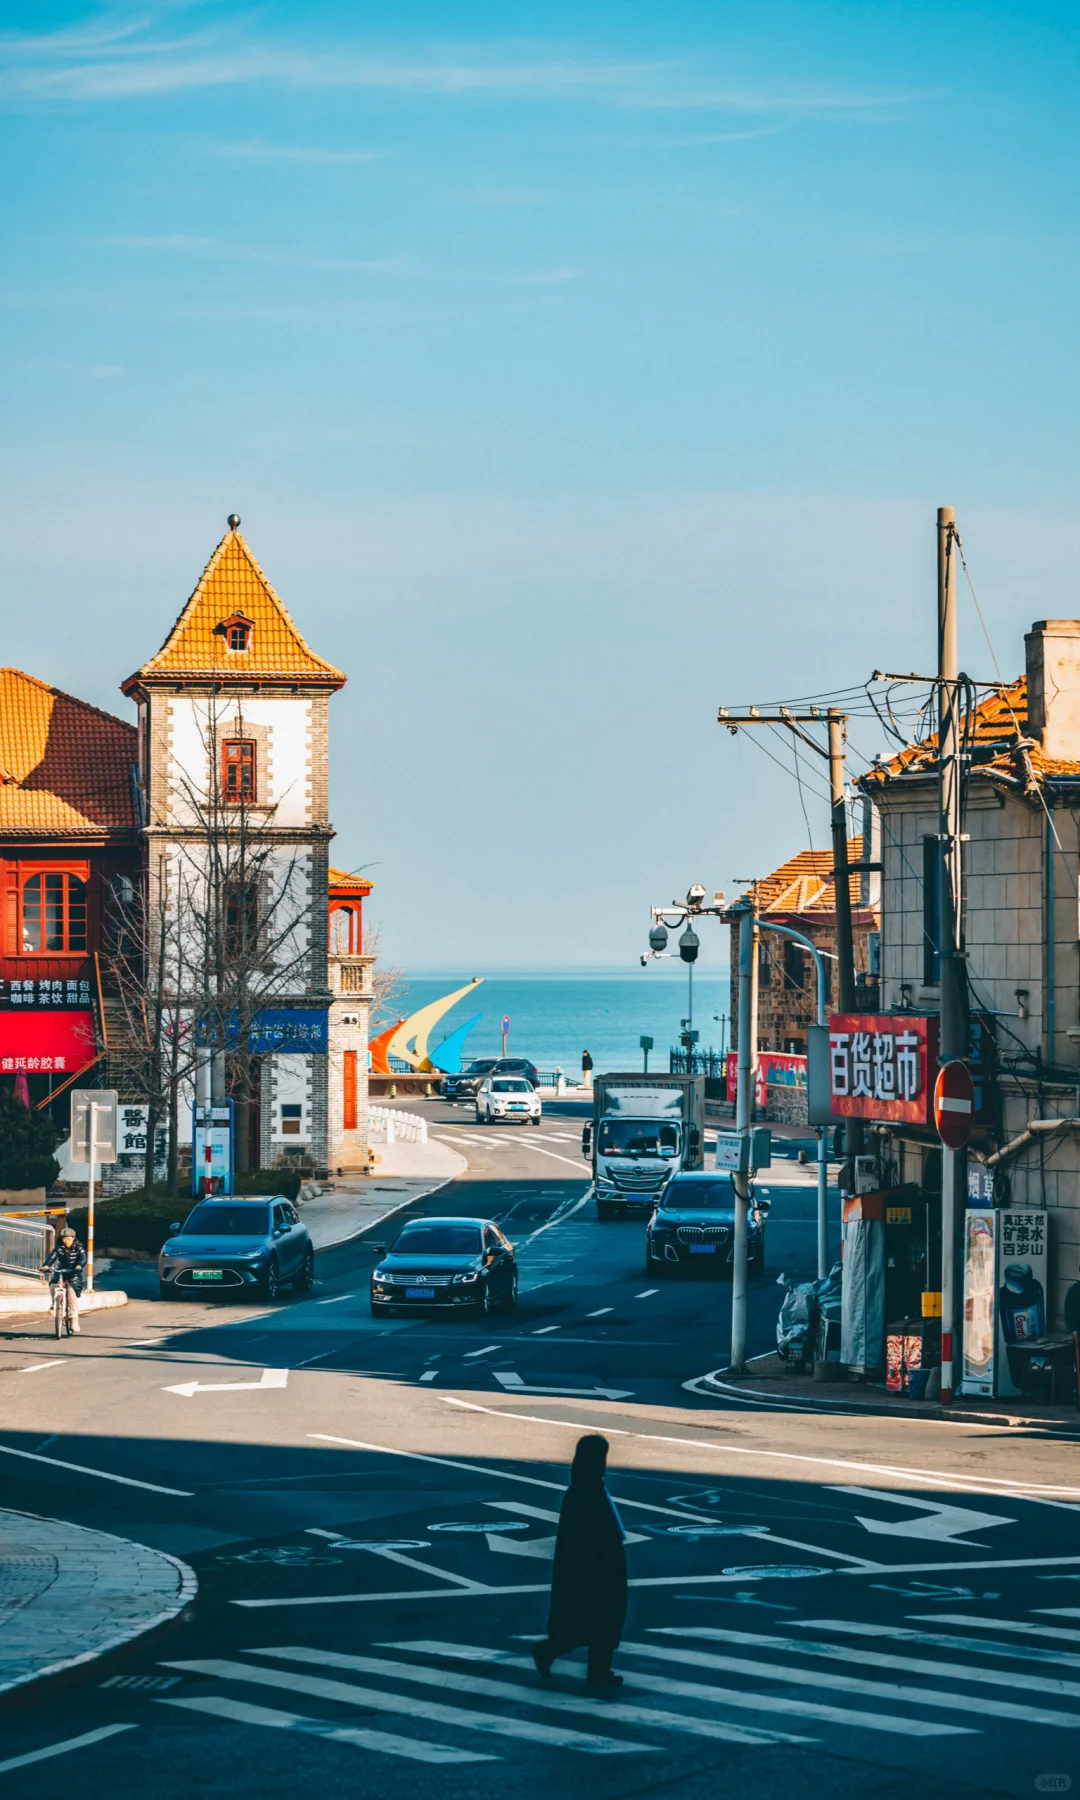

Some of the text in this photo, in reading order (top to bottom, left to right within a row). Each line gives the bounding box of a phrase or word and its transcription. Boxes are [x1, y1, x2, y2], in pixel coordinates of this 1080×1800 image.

[10, 980, 34, 991] 西餐
[38, 980, 63, 991] 烤肉
[66, 980, 90, 991] 面包
[10, 993, 90, 1004] 咖啡 茶饮 甜品
[1, 1056, 66, 1070] 健延龄胶囊
[829, 1030, 920, 1102] 百货超市
[121, 1109, 148, 1149] 醫館
[968, 1171, 994, 1201] 烟草
[1003, 1214, 1045, 1227] 真正天然
[1003, 1227, 1044, 1242] 矿泉水
[1003, 1243, 1044, 1257] 百岁山
